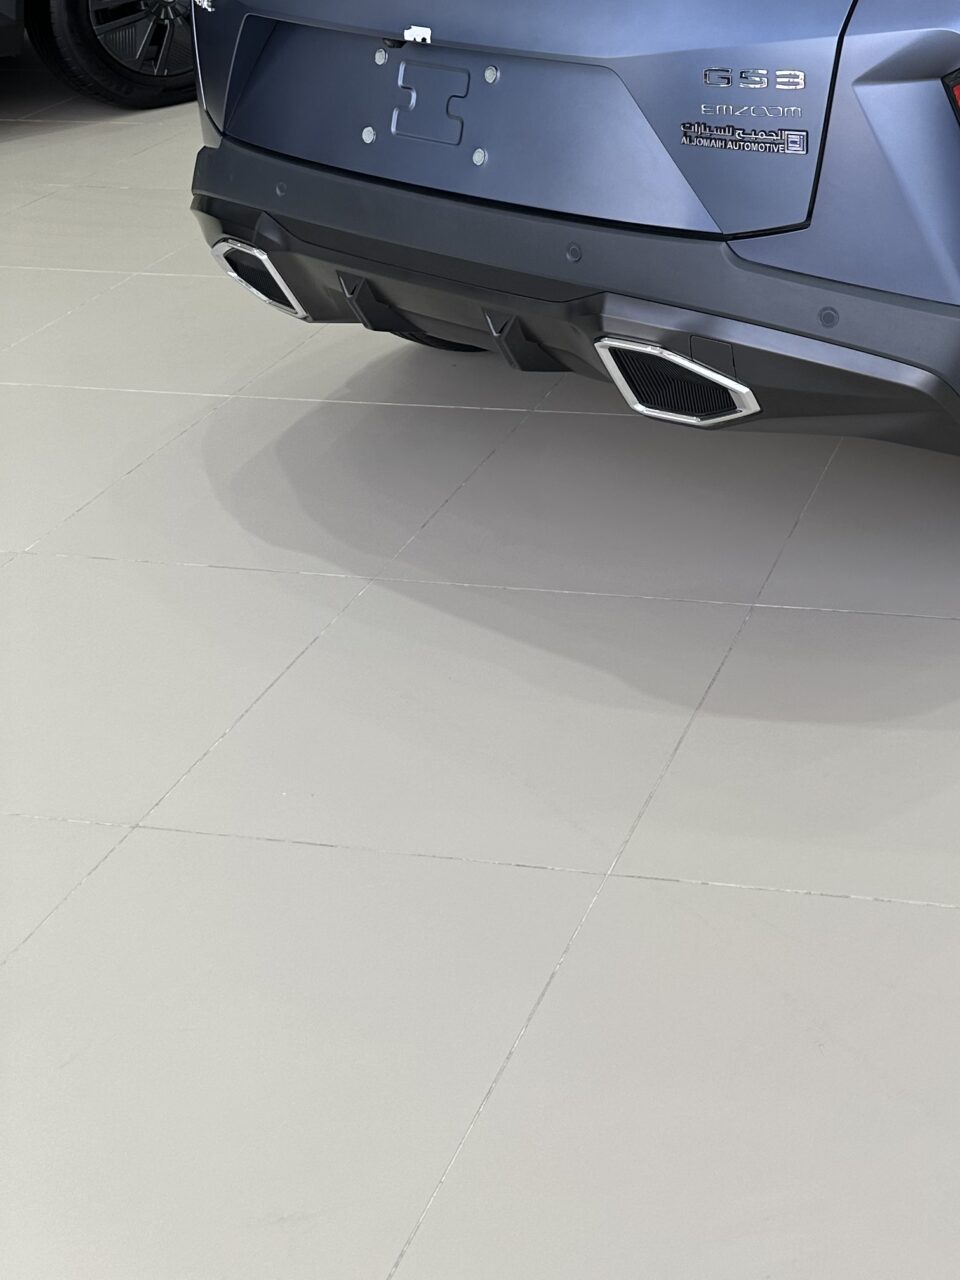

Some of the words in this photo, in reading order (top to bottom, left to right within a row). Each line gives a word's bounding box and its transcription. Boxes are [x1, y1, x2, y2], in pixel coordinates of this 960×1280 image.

[702, 66, 807, 91] GS3
[680, 122, 735, 136] للسيارات
[735, 127, 785, 141] الجميح
[726, 141, 785, 154] AUTOMOTIVE
